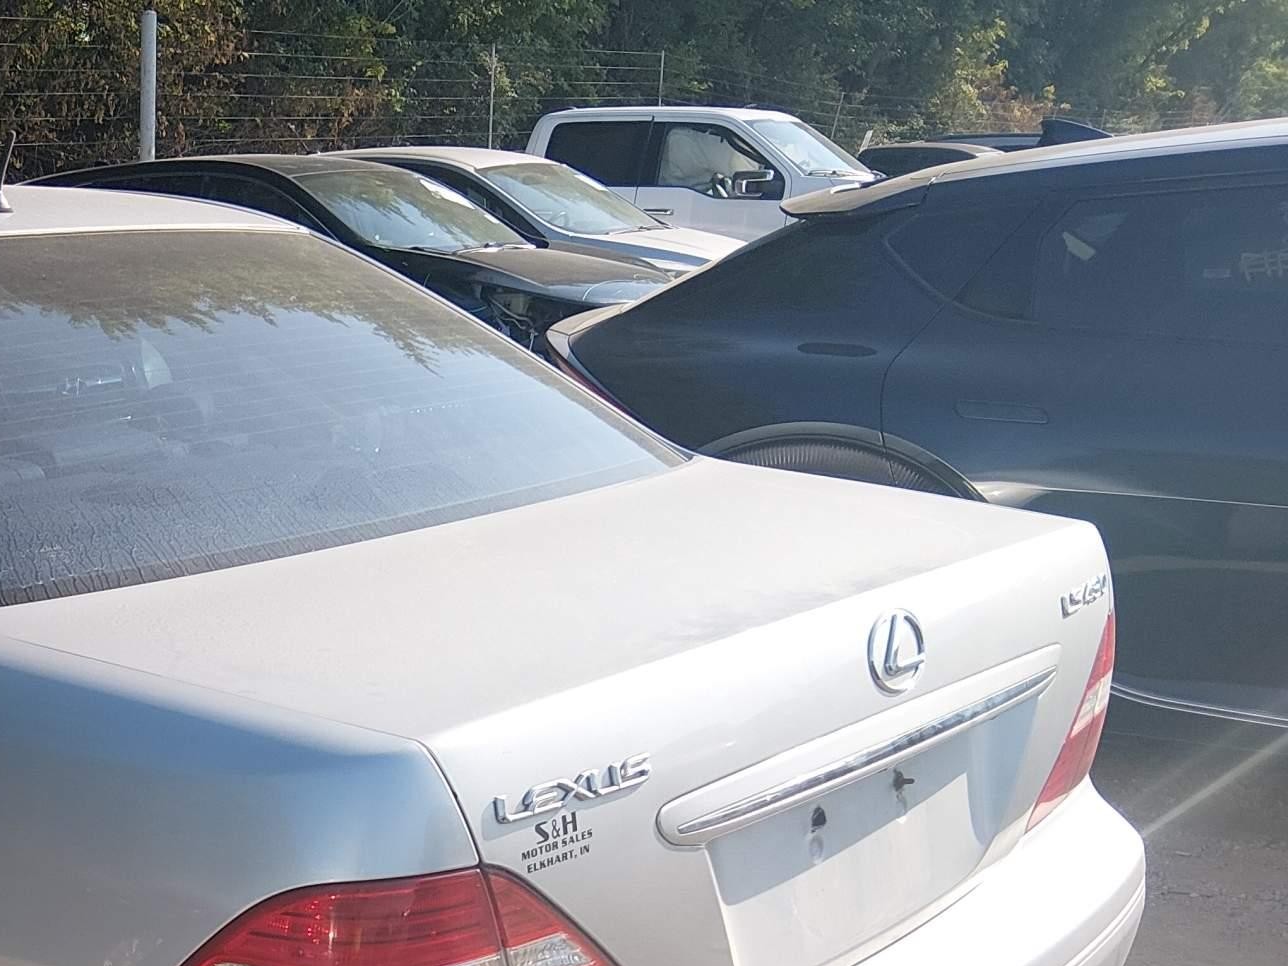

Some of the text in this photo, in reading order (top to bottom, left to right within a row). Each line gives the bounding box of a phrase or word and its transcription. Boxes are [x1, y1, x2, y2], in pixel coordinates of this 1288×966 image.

[493, 752, 651, 824] LEXUS
[521, 828, 593, 861] MOTOR SALES
[534, 811, 578, 845] S&H
[526, 844, 591, 874] ELKHART, IN
